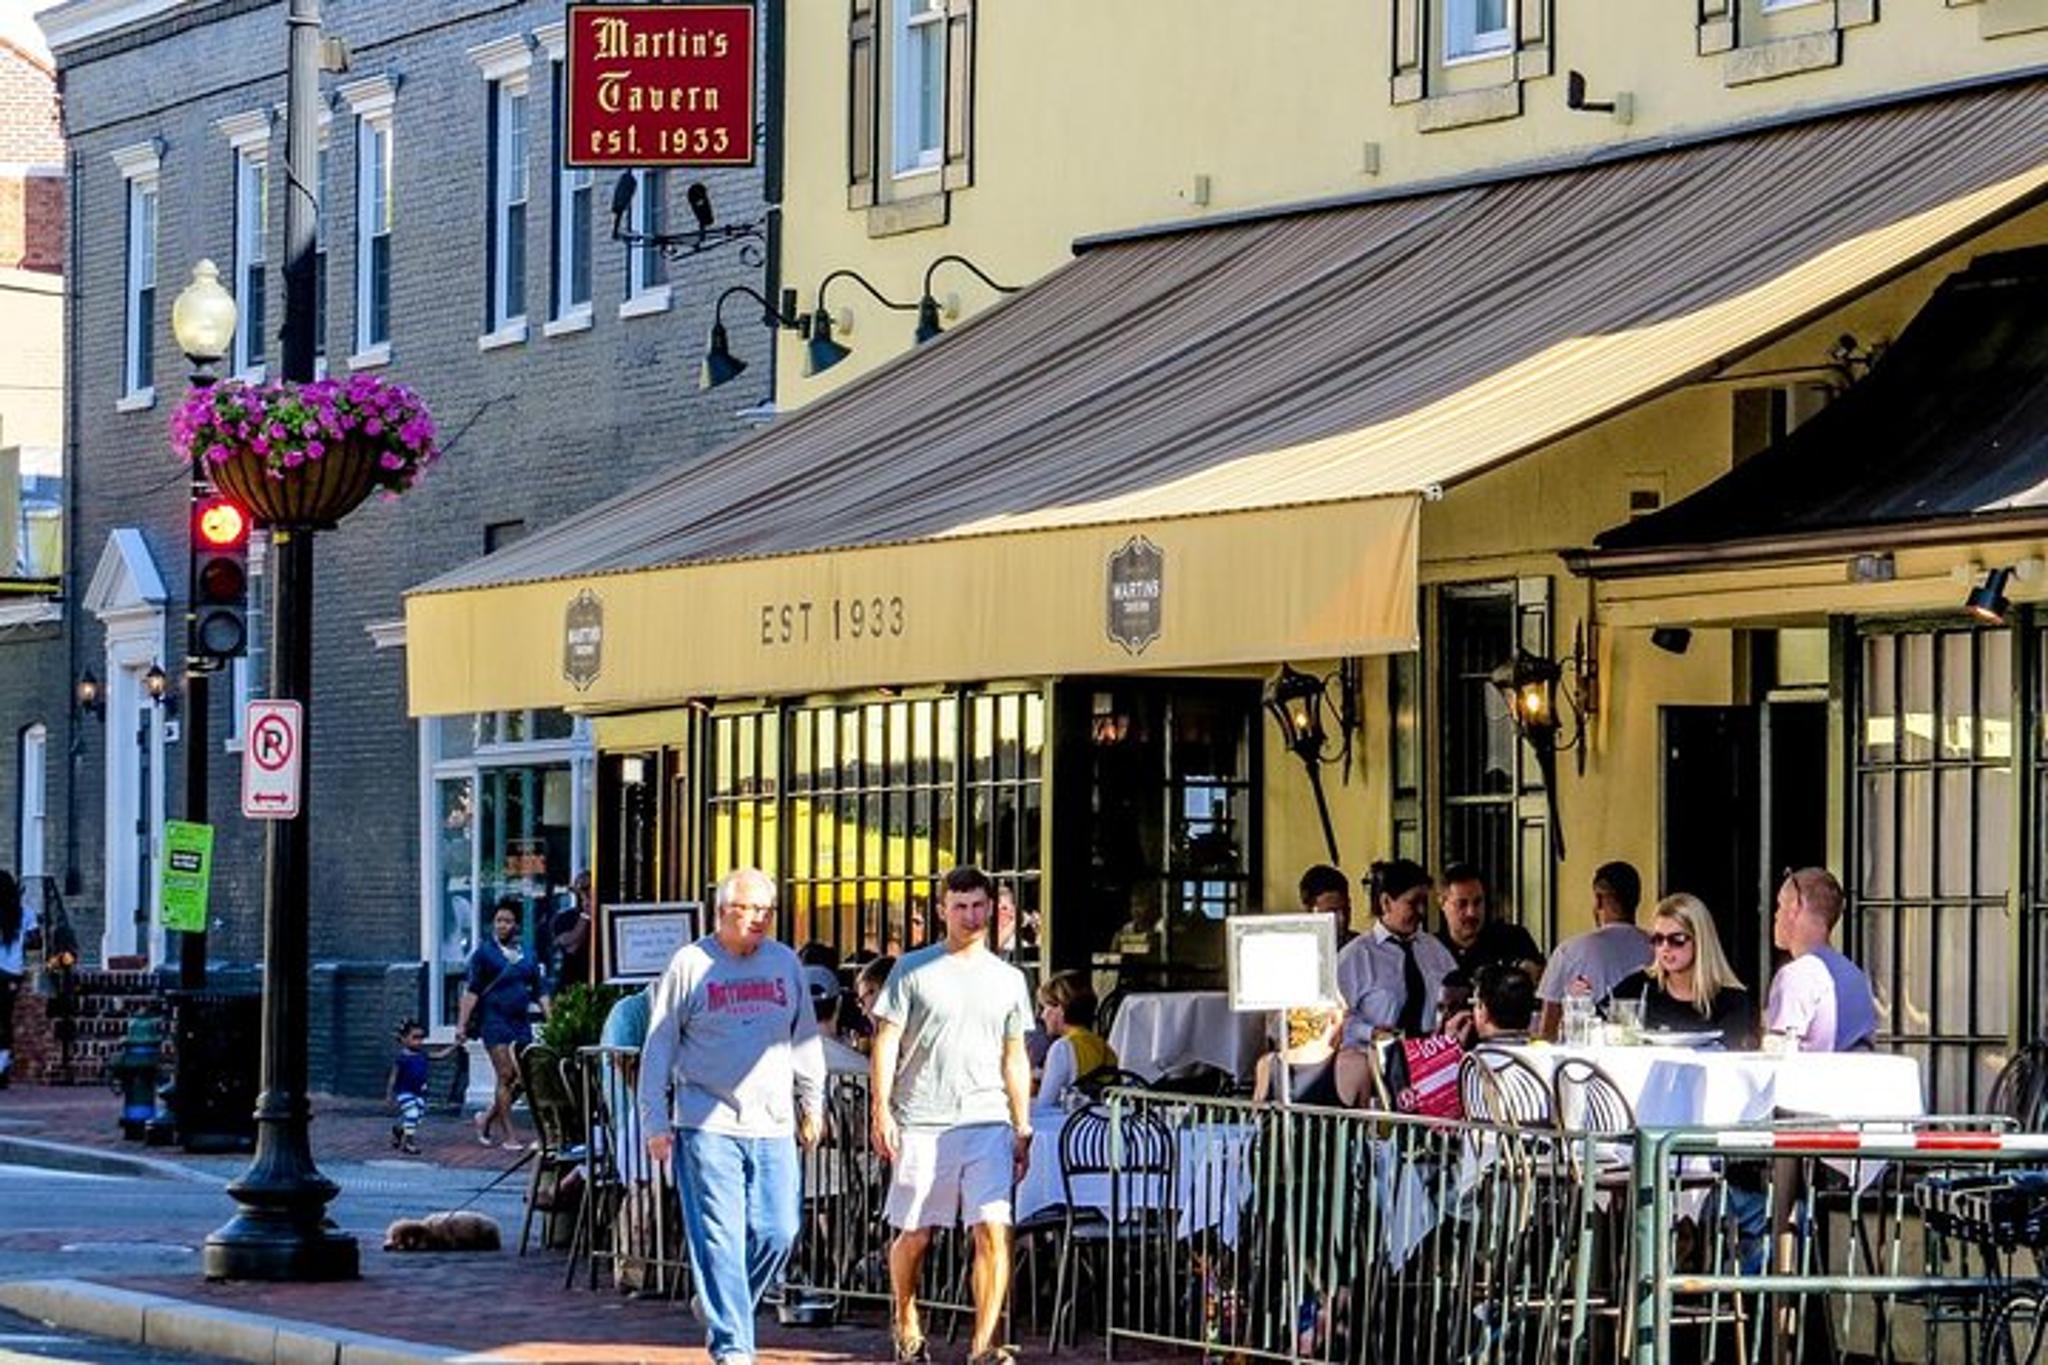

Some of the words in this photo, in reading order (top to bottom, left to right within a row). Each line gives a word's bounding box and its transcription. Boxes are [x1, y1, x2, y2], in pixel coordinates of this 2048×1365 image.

[591, 16, 729, 61] Martin's
[597, 70, 720, 114] Tavern
[591, 124, 642, 154] est.
[659, 127, 730, 154] 1933
[761, 602, 813, 645] EST
[833, 597, 904, 641] 1933
